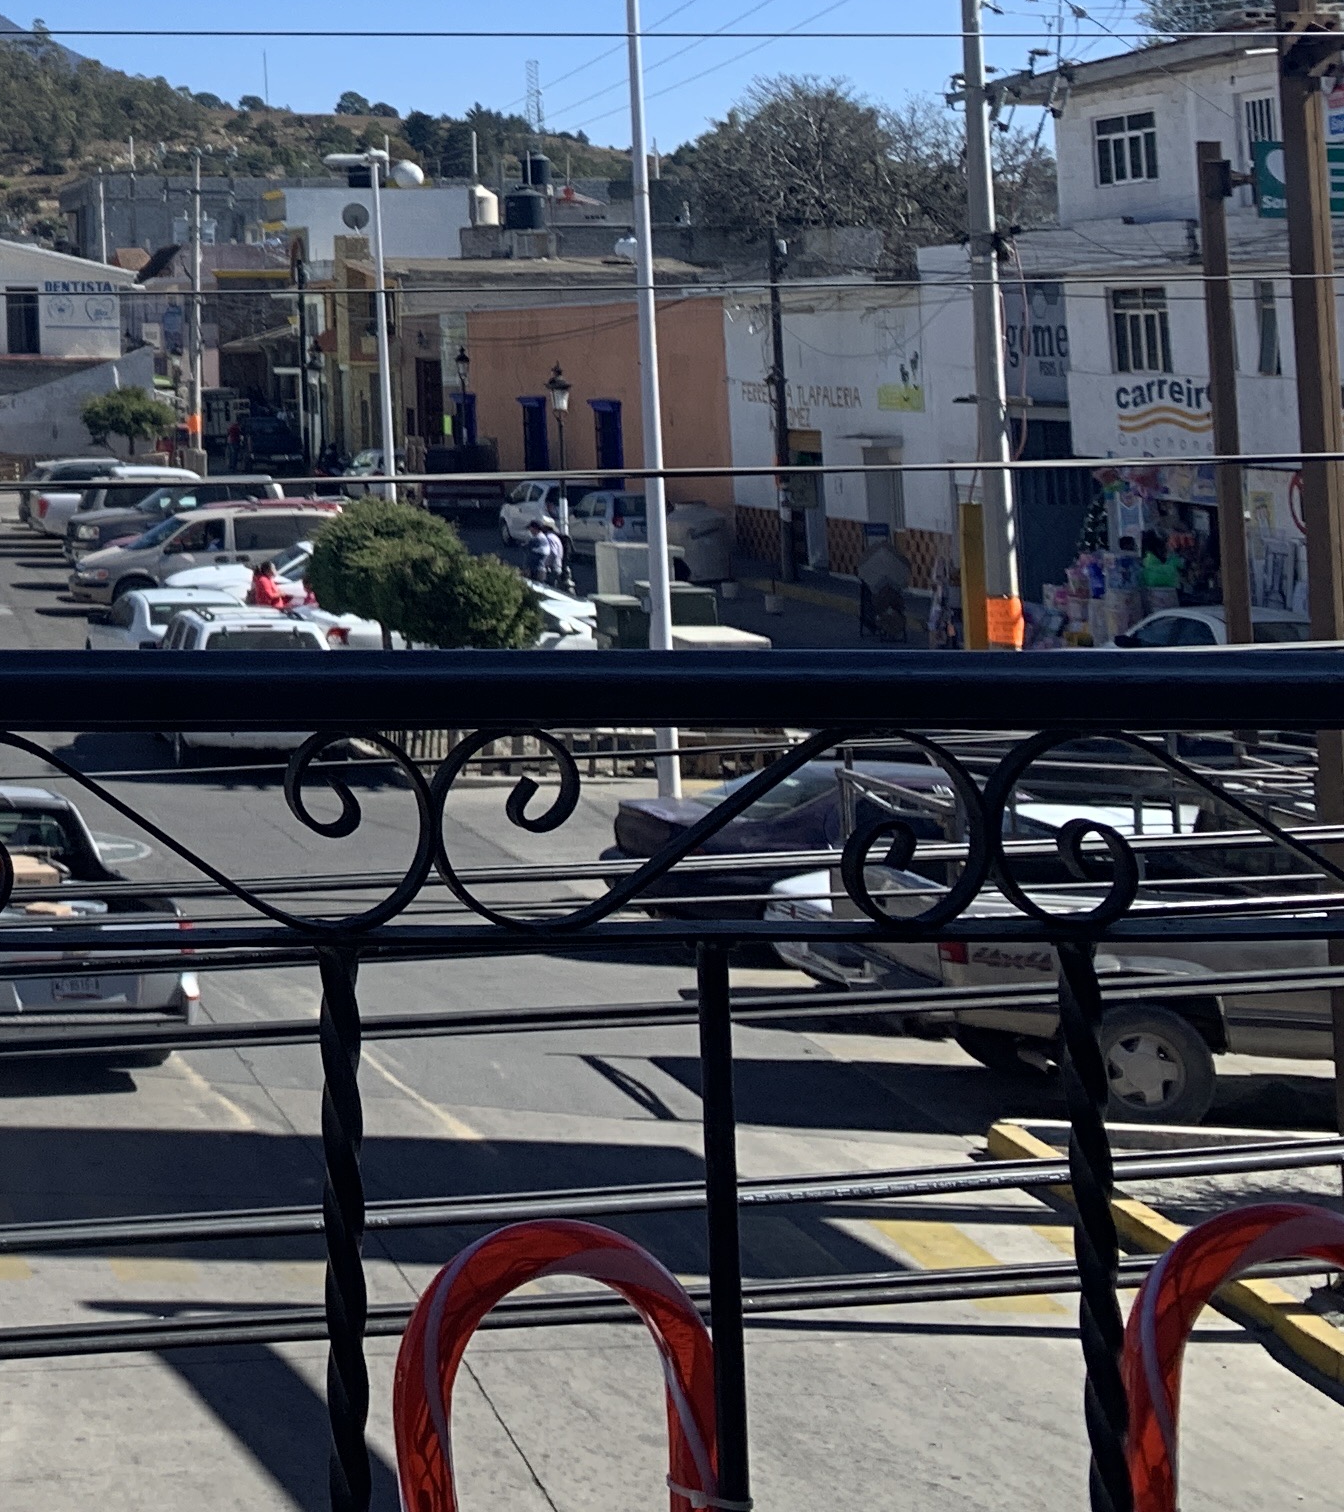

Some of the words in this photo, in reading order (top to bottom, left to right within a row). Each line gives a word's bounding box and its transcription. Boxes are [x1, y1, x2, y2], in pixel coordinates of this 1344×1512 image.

[1006, 324, 1068, 367] gome
[797, 386, 863, 409] TLAPALERIA
[1118, 433, 1213, 451] Colchone
[973, 947, 1052, 971] 4x4
